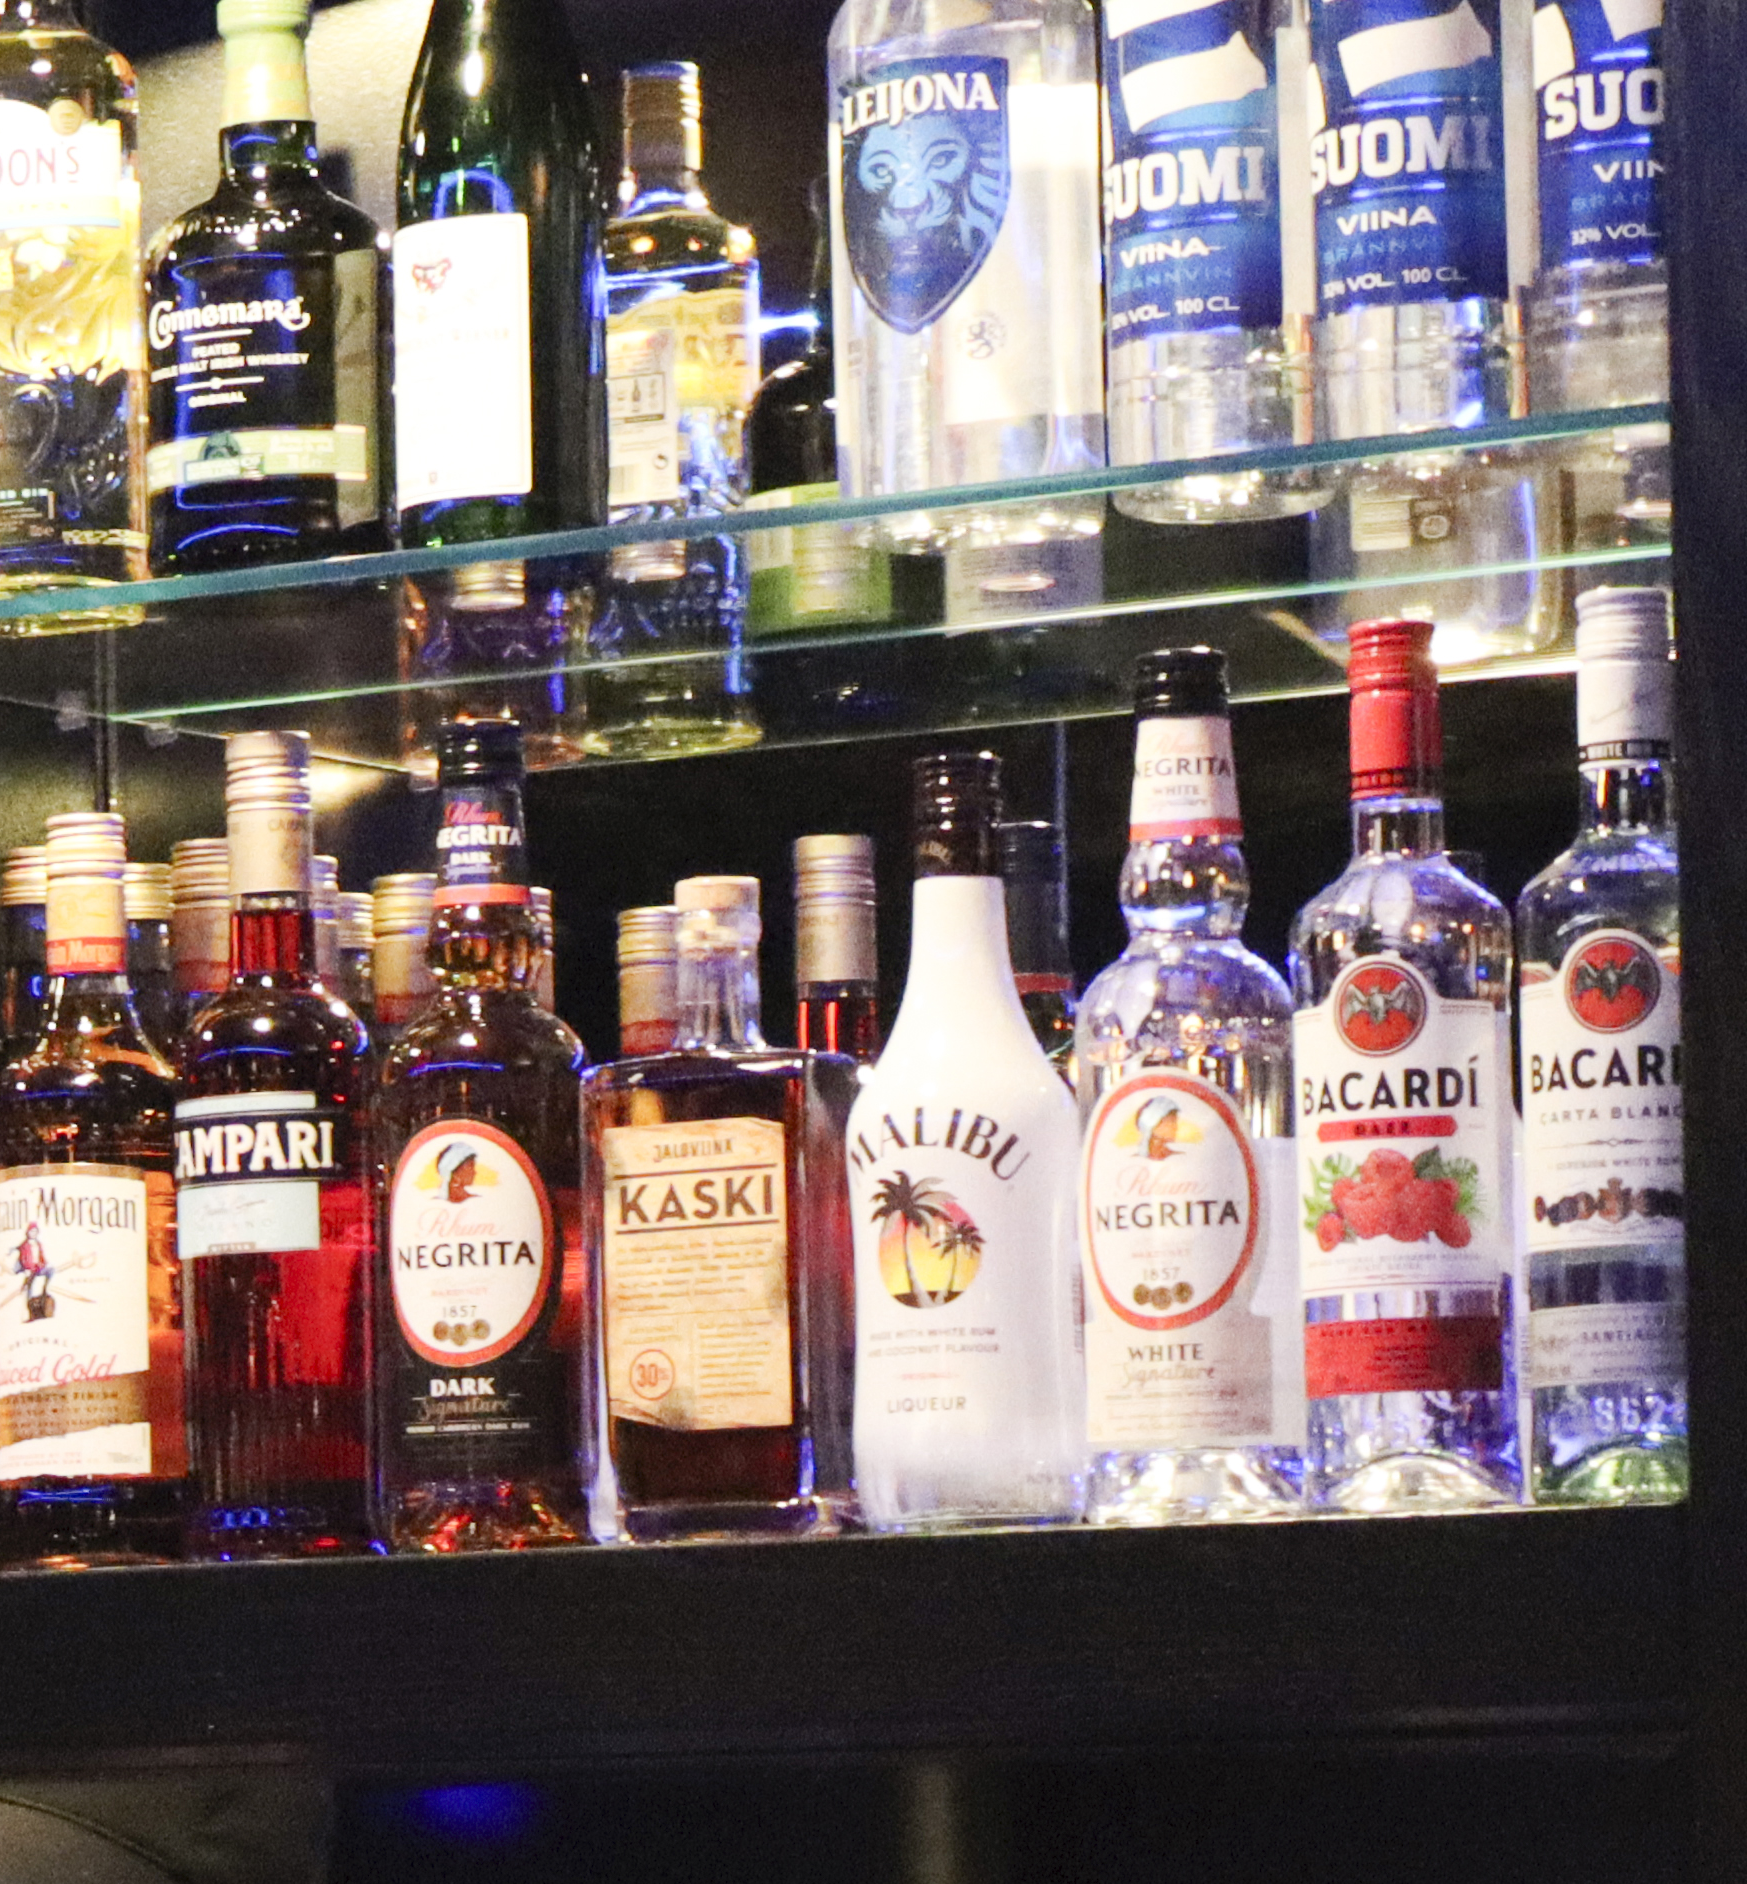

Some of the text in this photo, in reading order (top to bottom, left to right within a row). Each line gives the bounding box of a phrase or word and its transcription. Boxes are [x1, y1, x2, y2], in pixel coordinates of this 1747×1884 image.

[841, 72, 999, 136] LEIJONA
[1310, 115, 1493, 195] SUOMI
[1337, 205, 1438, 236] VIINA
[1120, 236, 1211, 269] VIINA
[1401, 267, 1432, 286] 100
[1175, 295, 1242, 316] 100 CL
[246, 352, 310, 367] WHISKEY
[450, 851, 491, 866] DARK
[1302, 1056, 1482, 1117] BACARDÍ
[1539, 1107, 1601, 1127] CARTA
[175, 1120, 333, 1180] AMPARI
[653, 1138, 736, 1164] JALOVIINA
[851, 1106, 1030, 1181] MALIBU
[37, 1186, 138, 1243] Morgan
[619, 1173, 776, 1226] KASKI
[415, 1207, 498, 1241] Rhum
[1095, 1199, 1242, 1233] NEGRITA
[397, 1240, 537, 1272] NEGRITA
[1143, 1266, 1182, 1281] 1857
[442, 1304, 478, 1319] 1857
[1127, 1342, 1205, 1363] WHITE
[52, 1353, 119, 1386] Gold
[430, 1376, 496, 1398] DARK
[887, 1396, 968, 1414] LIQUEUR
